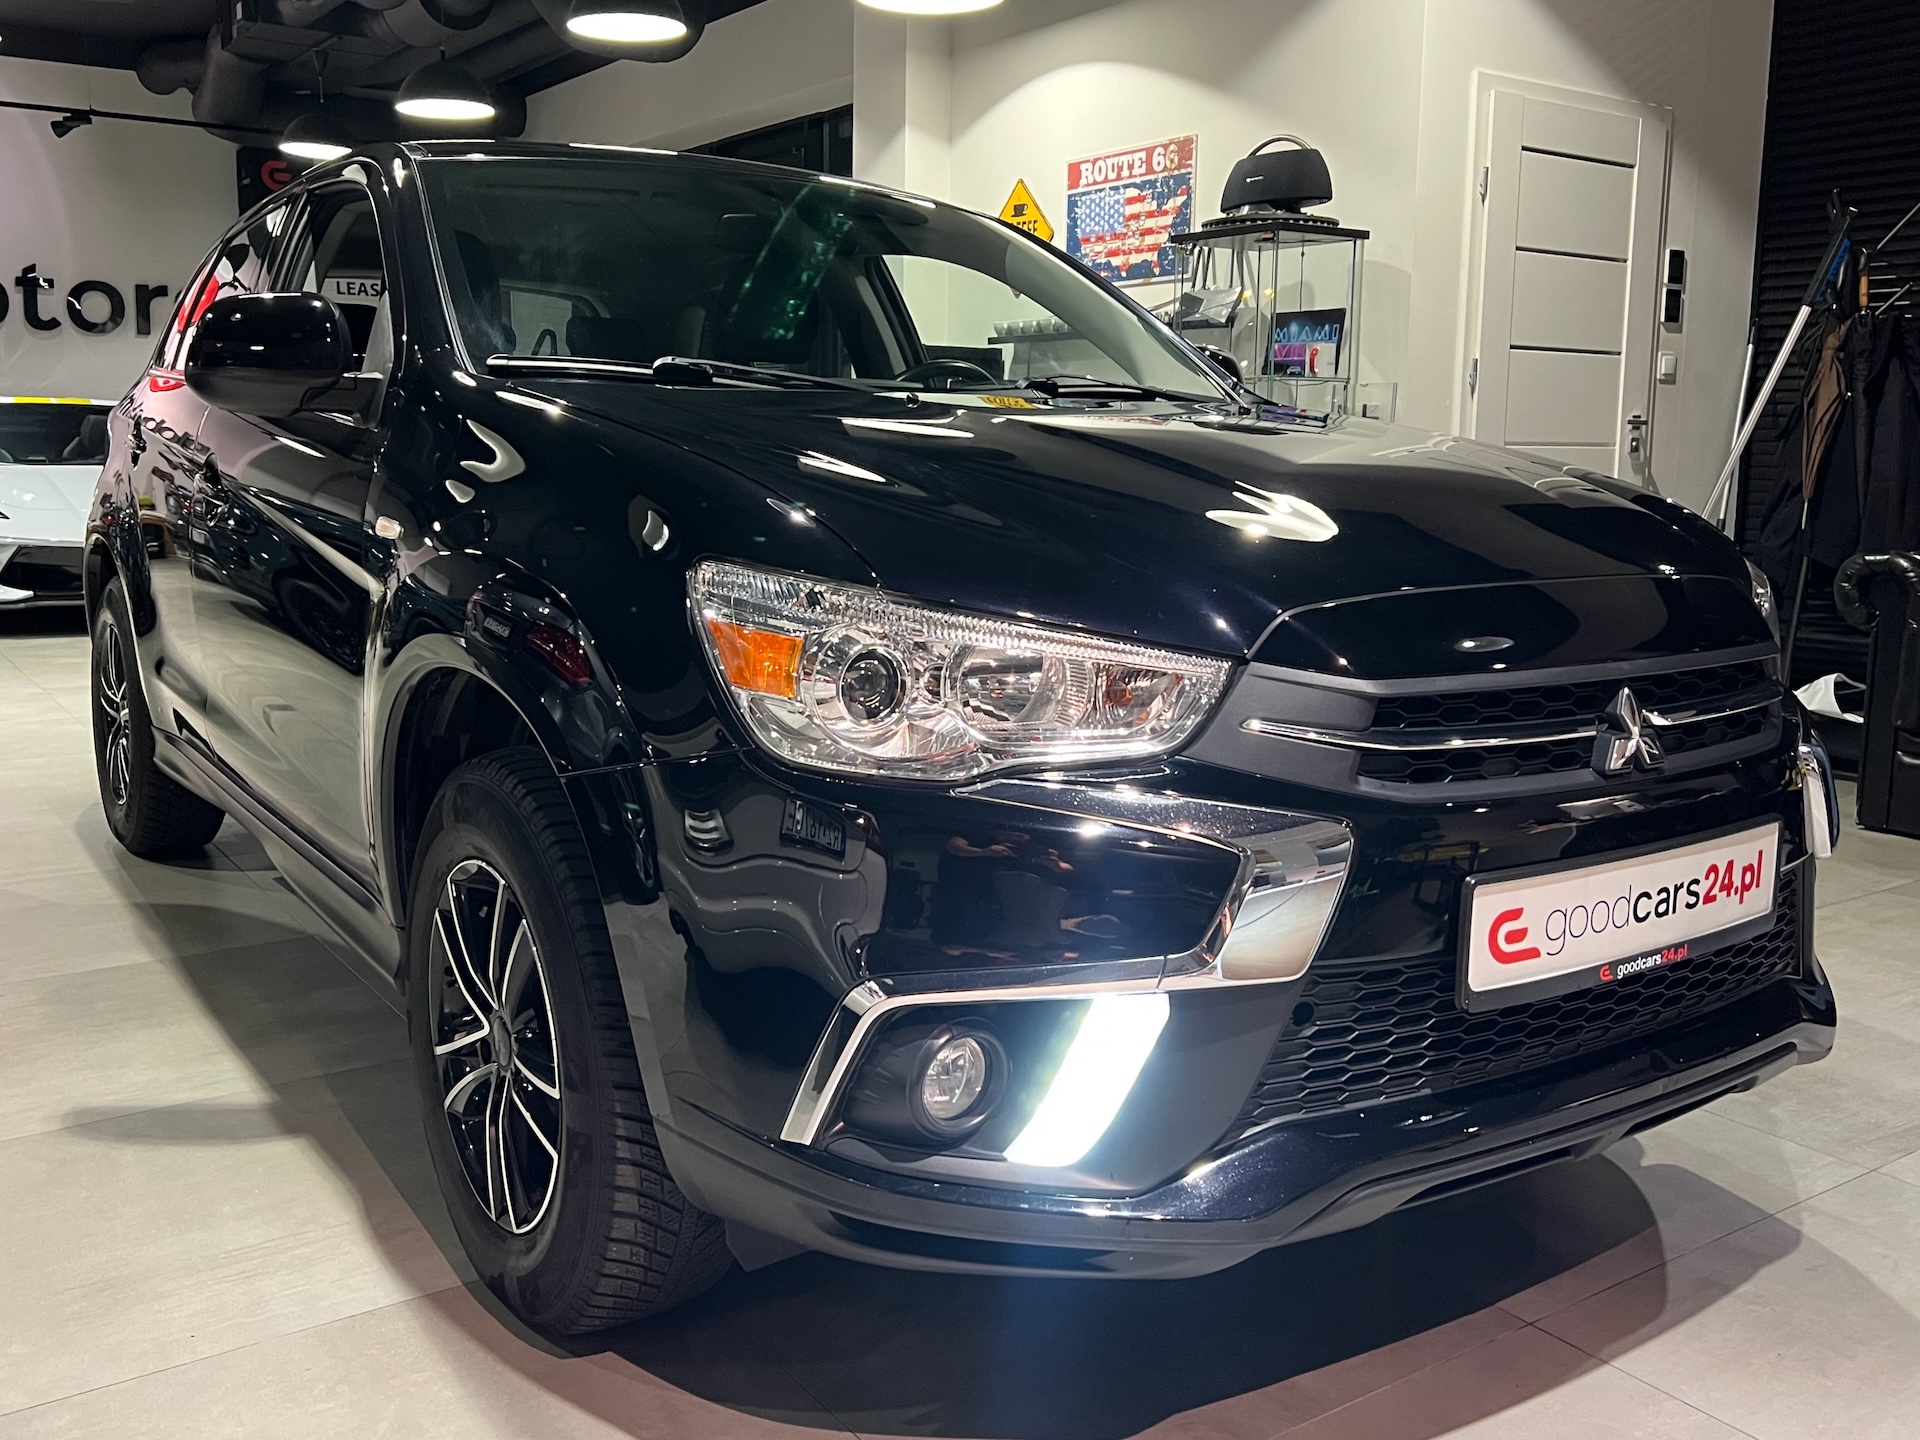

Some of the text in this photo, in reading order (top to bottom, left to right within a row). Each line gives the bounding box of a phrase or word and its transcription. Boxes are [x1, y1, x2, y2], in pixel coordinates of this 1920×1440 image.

[1079, 143, 1179, 186] ROUTE 66
[0, 263, 182, 336] tor
[1274, 324, 1340, 342] MIAMI
[1546, 849, 1764, 956] goodcars24.pl
[1617, 944, 1688, 979] goodcars24.pl
